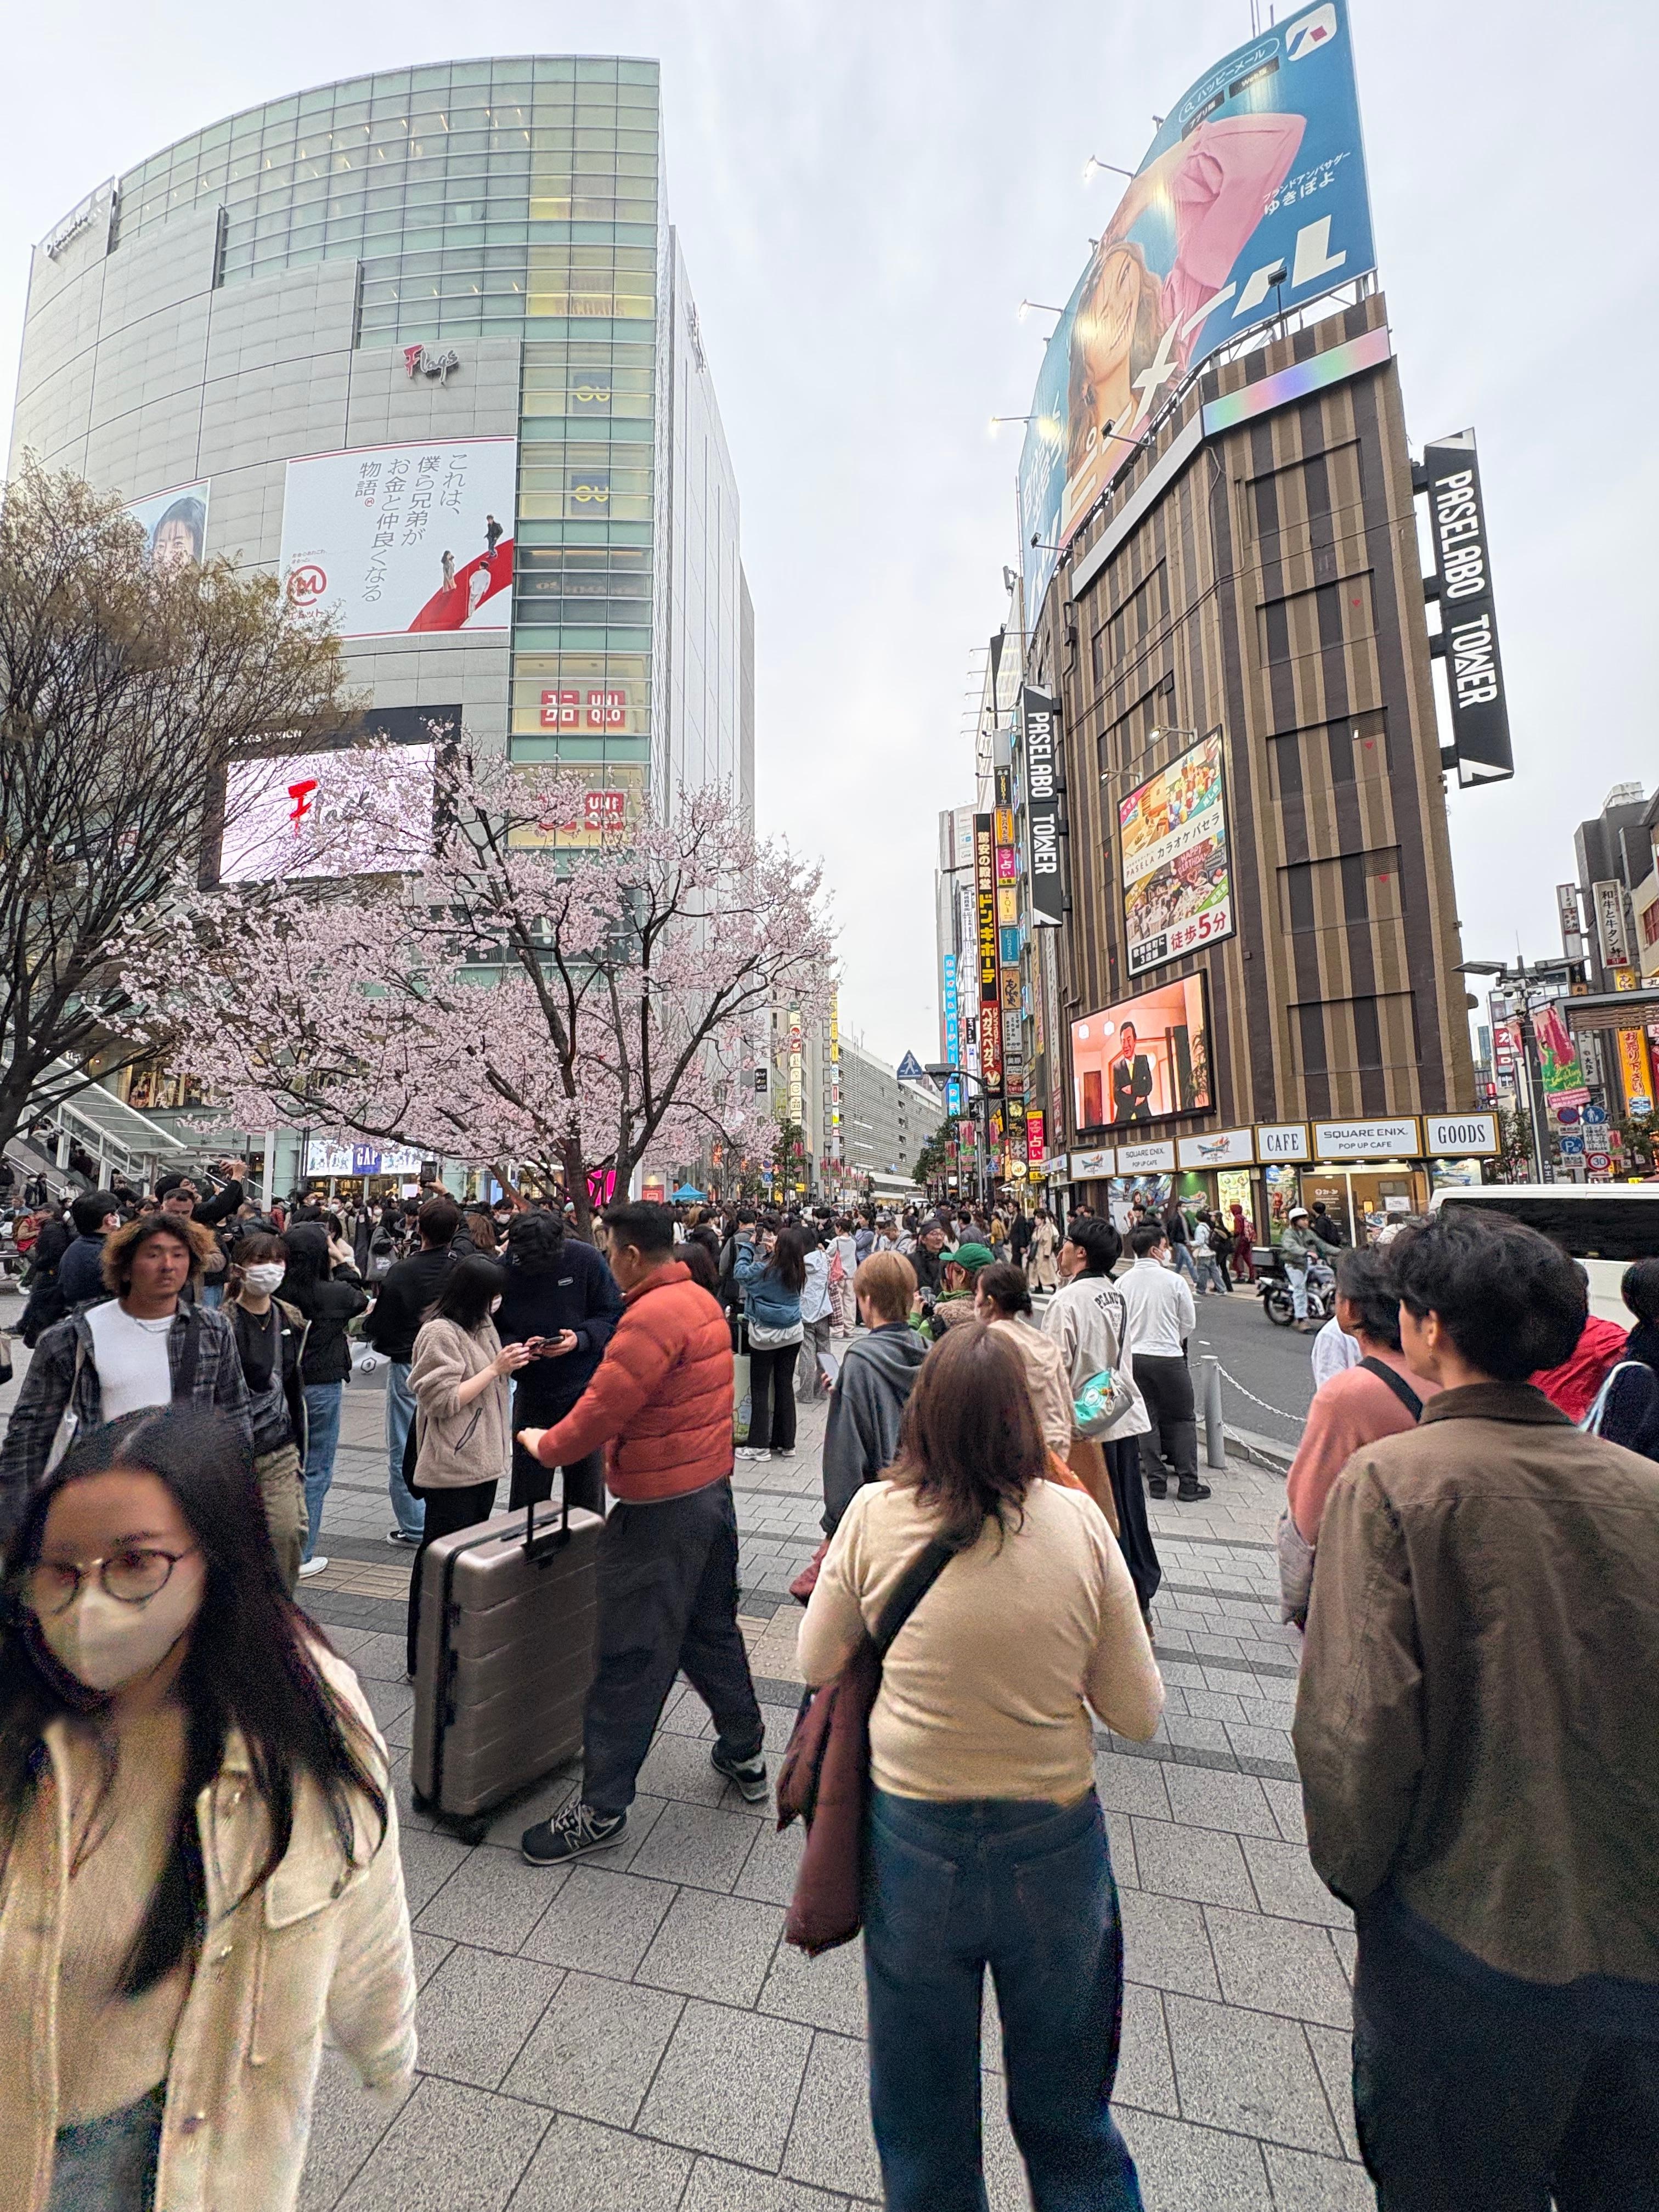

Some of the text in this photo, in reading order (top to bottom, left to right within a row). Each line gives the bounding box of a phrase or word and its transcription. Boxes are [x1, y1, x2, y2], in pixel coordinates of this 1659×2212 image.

[1198, 49, 1266, 102] ハッピーメール
[1262, 151, 1351, 204] ブランドアンバサダー
[1264, 171, 1335, 216] ゆきぽよ
[404, 344, 459, 383] Flags
[401, 455, 441, 546] 僕ら兄弟が
[439, 454, 467, 515] これは、
[362, 458, 410, 602] お金と仲良くなる
[1435, 469, 1498, 709] PASELABO TOWER
[591, 694, 618, 706] UNI
[591, 709, 621, 724] QLO
[1028, 712, 1058, 875] PASELABO TOWER
[1126, 856, 1155, 878] PASELA
[1170, 911, 1226, 952] 徒歩5分
[981, 1007, 995, 1068] ベガスベガス
[1029, 1134, 1043, 1158] 占い
[1267, 1133, 1299, 1152] CAFE
[1323, 1127, 1406, 1139] SQUARE ENIX
[1437, 1125, 1486, 1144] GOODS
[357, 1147, 379, 1166] GAP
[1125, 1147, 1165, 1159] SQUARE ENIX
[1593, 1158, 1606, 1166] 30
